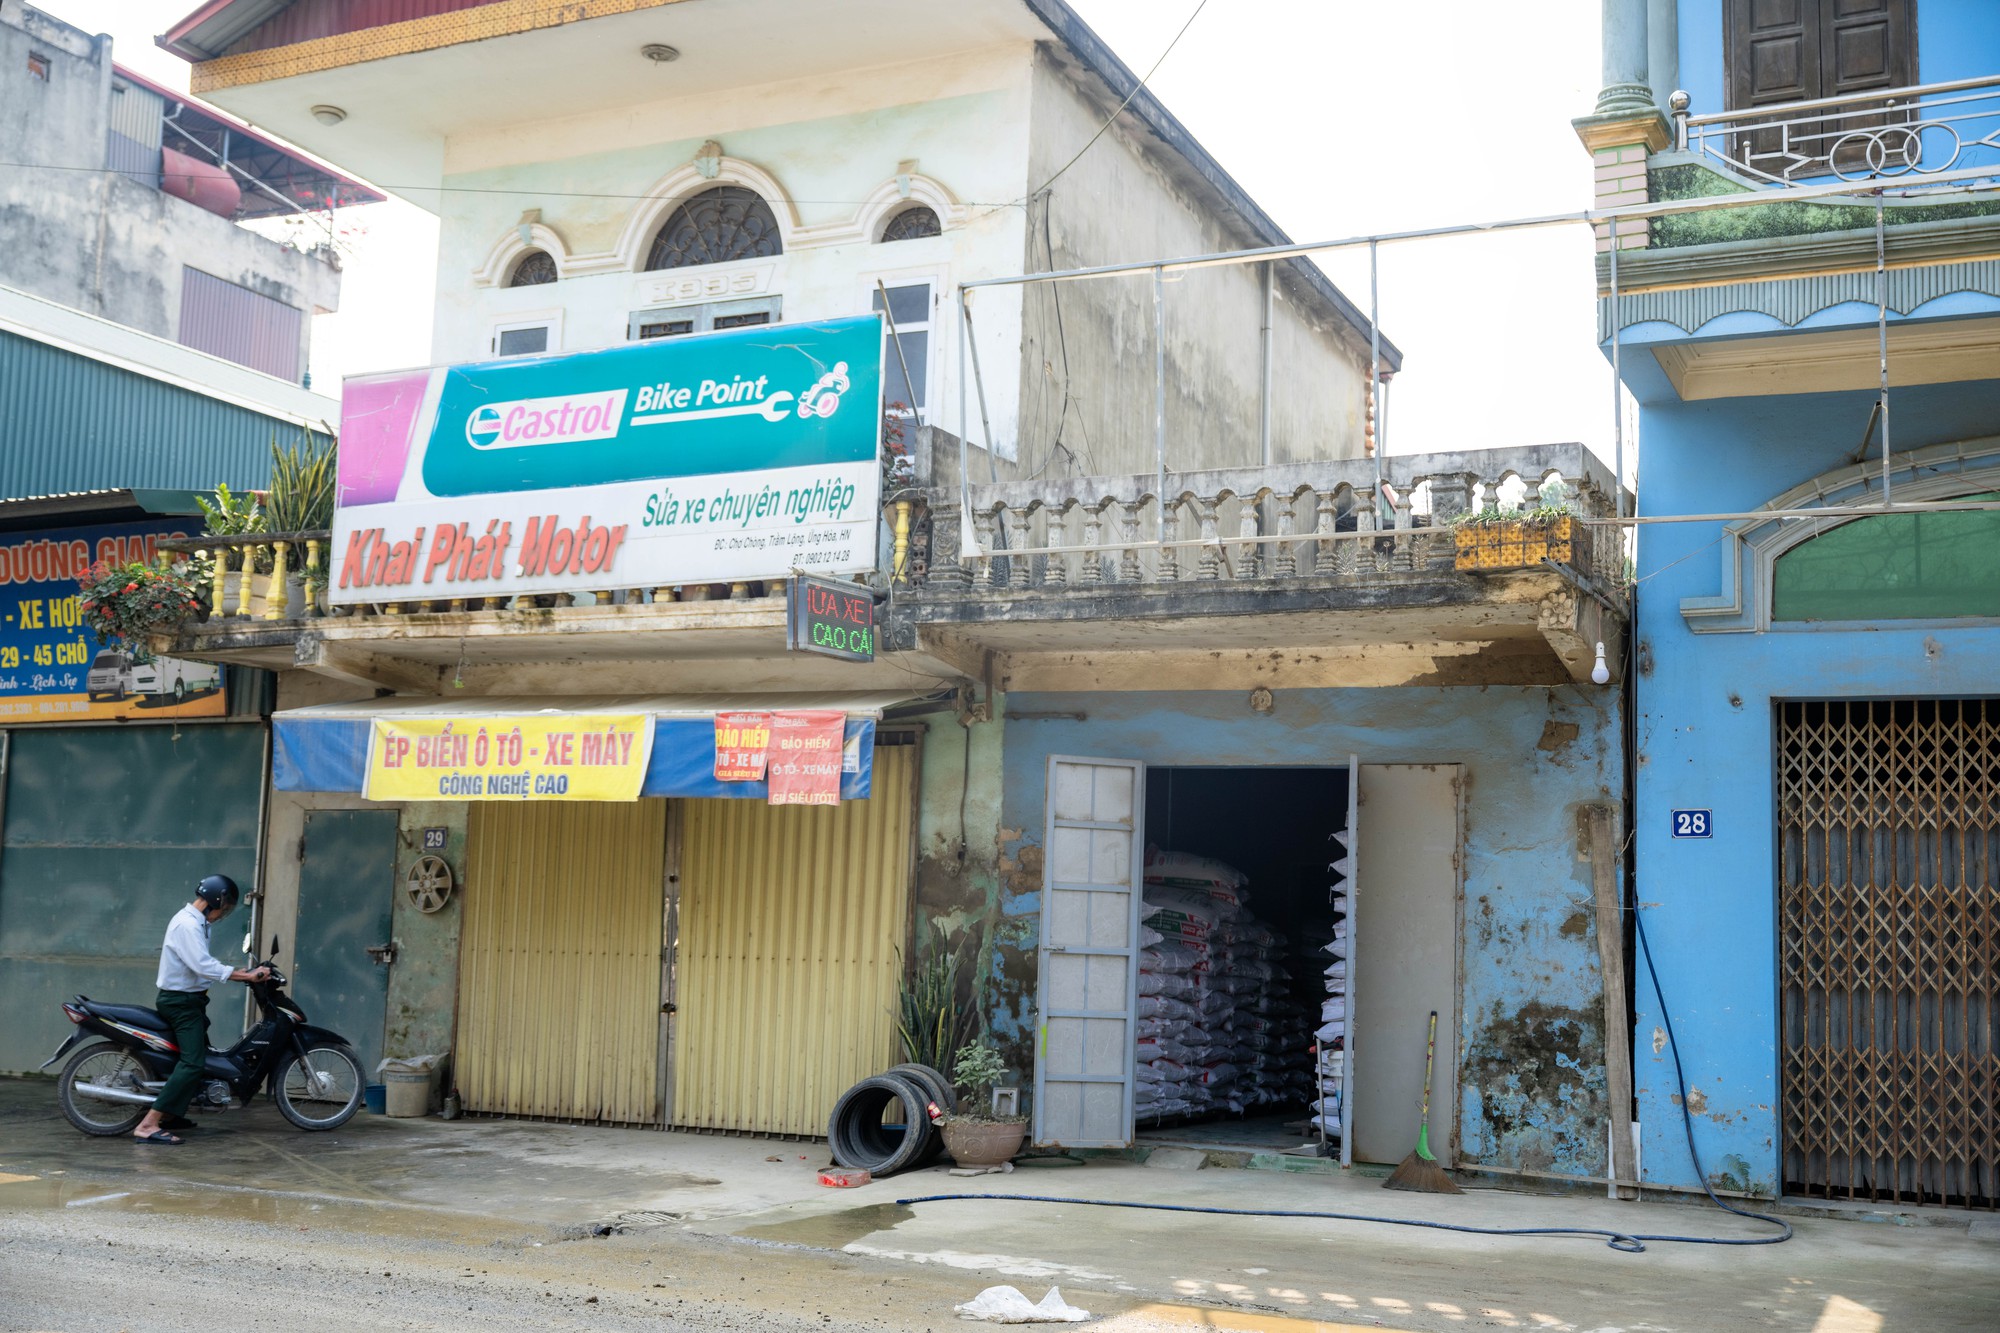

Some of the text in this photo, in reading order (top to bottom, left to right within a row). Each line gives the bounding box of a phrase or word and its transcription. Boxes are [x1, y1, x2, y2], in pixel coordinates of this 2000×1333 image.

[503, 375, 768, 442] Castrol Bike Point
[642, 477, 855, 528] Sửa xe chuyên nghiệp
[839, 529, 852, 541] HN
[338, 514, 628, 589] Khai Phát Motor
[18, 600, 44, 630] XE
[843, 597, 865, 625] XE
[34, 644, 52, 666] 45
[56, 634, 88, 666] CHỖ
[813, 622, 847, 650] CAO
[384, 730, 411, 768] ÉP
[416, 722, 468, 768] BIỂN
[474, 727, 490, 768] Ô
[496, 726, 523, 767] TÔ
[543, 733, 574, 766] XE
[580, 726, 635, 766] MÁY
[781, 734, 831, 750] BẢO HIỂM
[772, 763, 782, 775] Ô
[439, 771, 568, 799] CÔNG NGHỆ CAO
[1677, 813, 1706, 834] 28
[426, 831, 443, 847] 29
